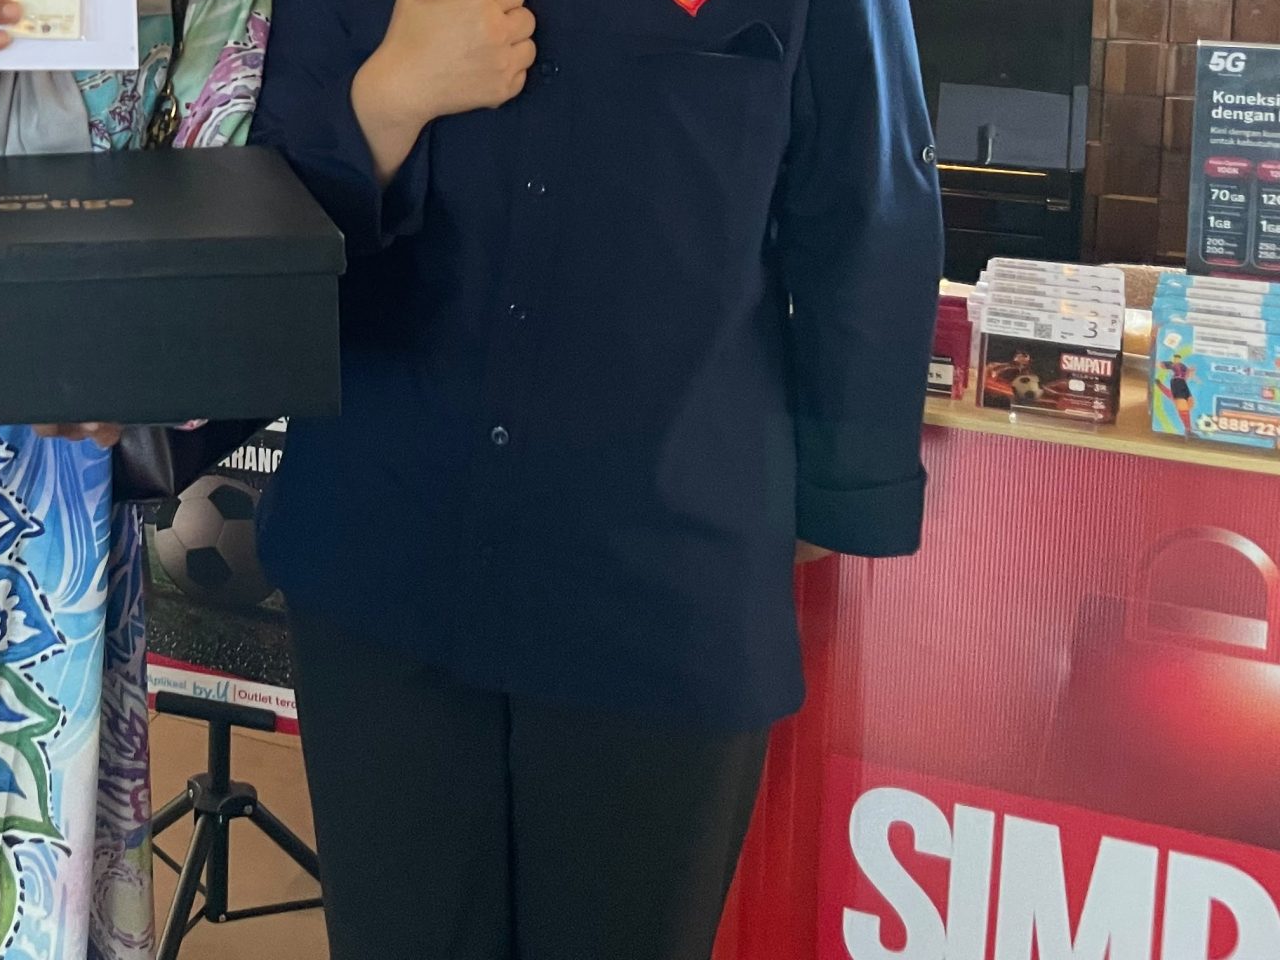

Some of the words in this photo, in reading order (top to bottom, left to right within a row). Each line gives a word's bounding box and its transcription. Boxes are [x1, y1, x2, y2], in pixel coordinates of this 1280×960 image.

[1208, 51, 1247, 73] 5G
[1212, 90, 1280, 106] Koneksi
[1211, 105, 1275, 123] dengan
[1210, 188, 1246, 203] 70GB
[1061, 354, 1112, 377] SIMPATI
[238, 689, 272, 705] Outlet
